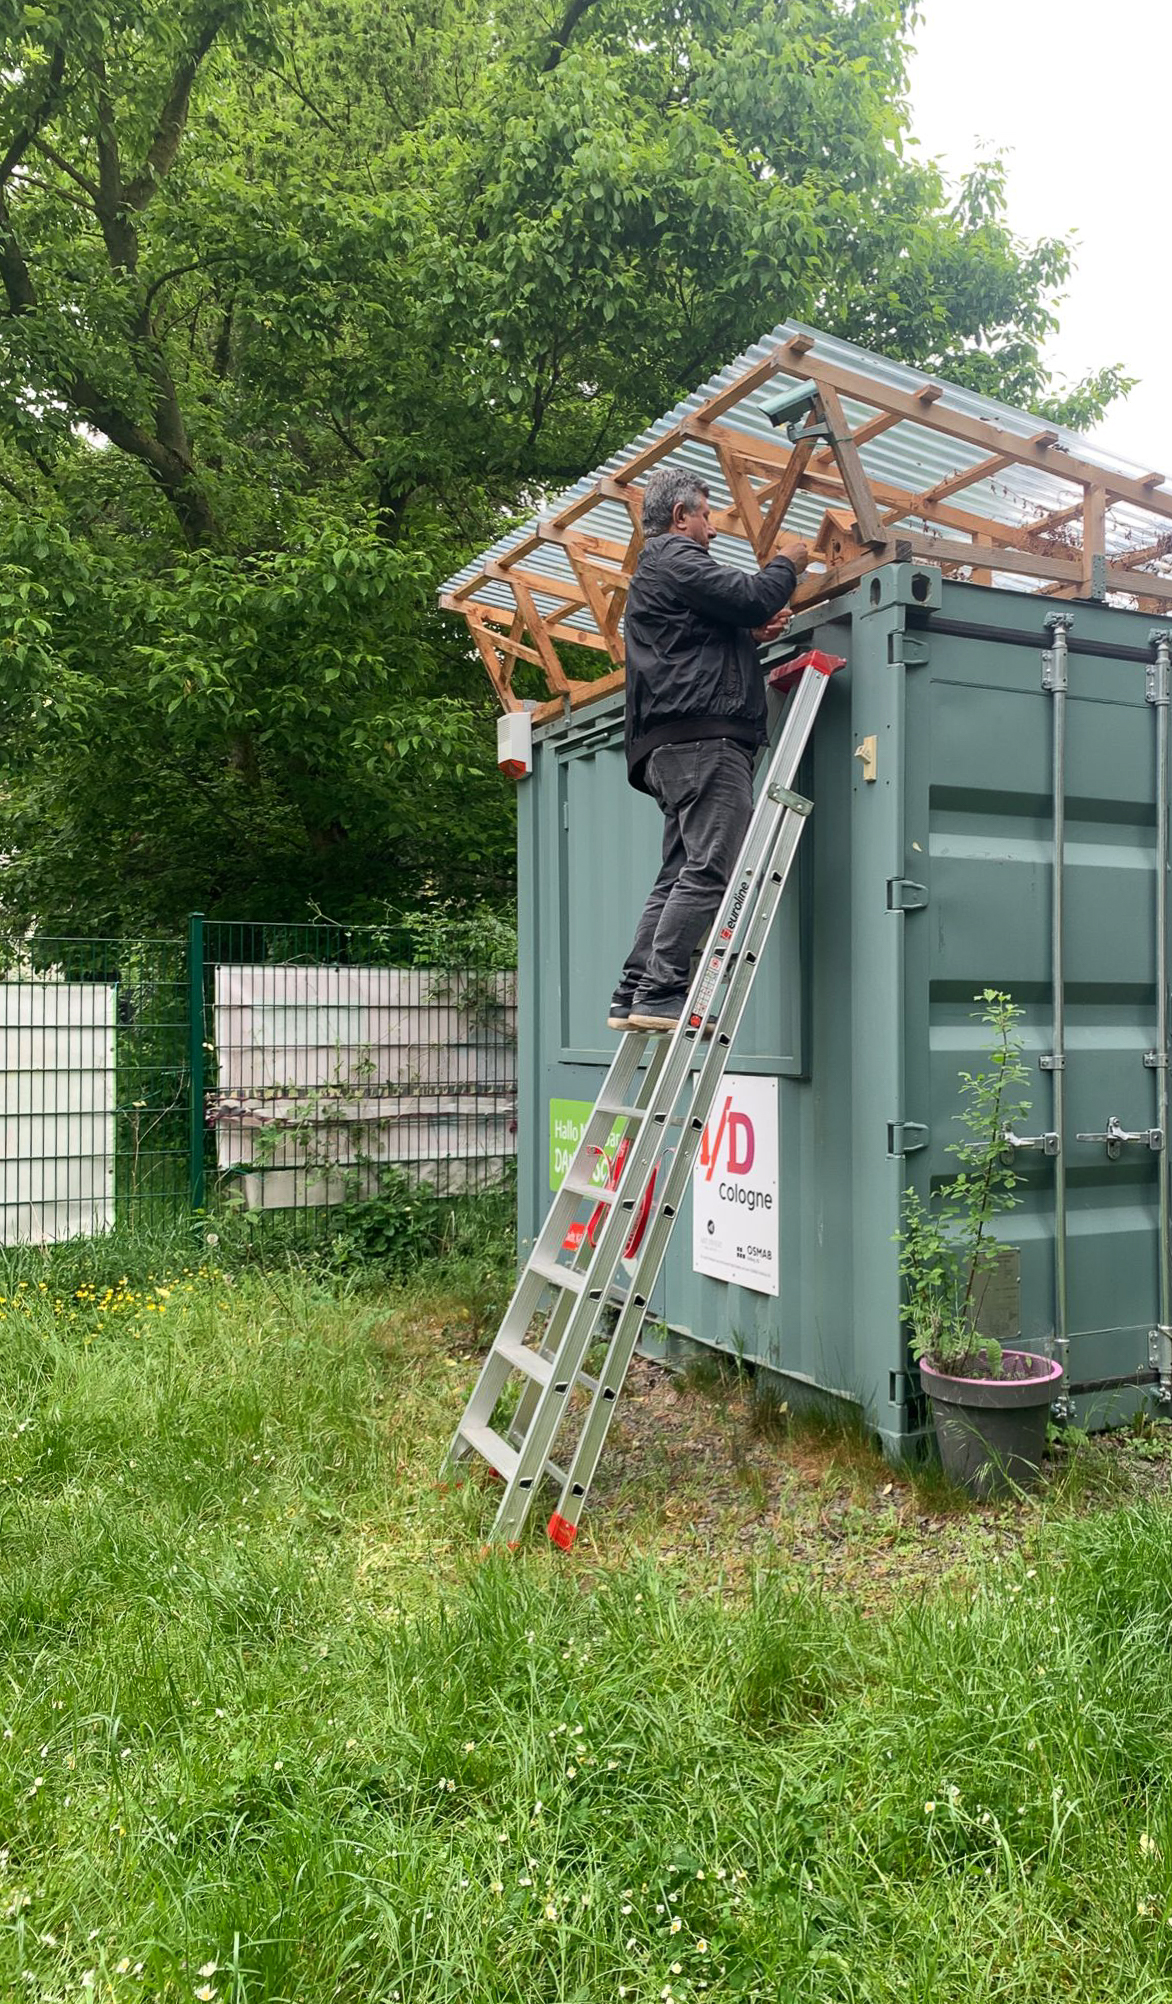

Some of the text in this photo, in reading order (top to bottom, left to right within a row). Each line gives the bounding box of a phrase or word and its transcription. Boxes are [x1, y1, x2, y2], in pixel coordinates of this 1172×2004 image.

[728, 881, 749, 929] euroline
[555, 1119, 578, 1141] Hallo
[719, 1183, 773, 1211] Cologne
[747, 1245, 772, 1261] OSMAB
